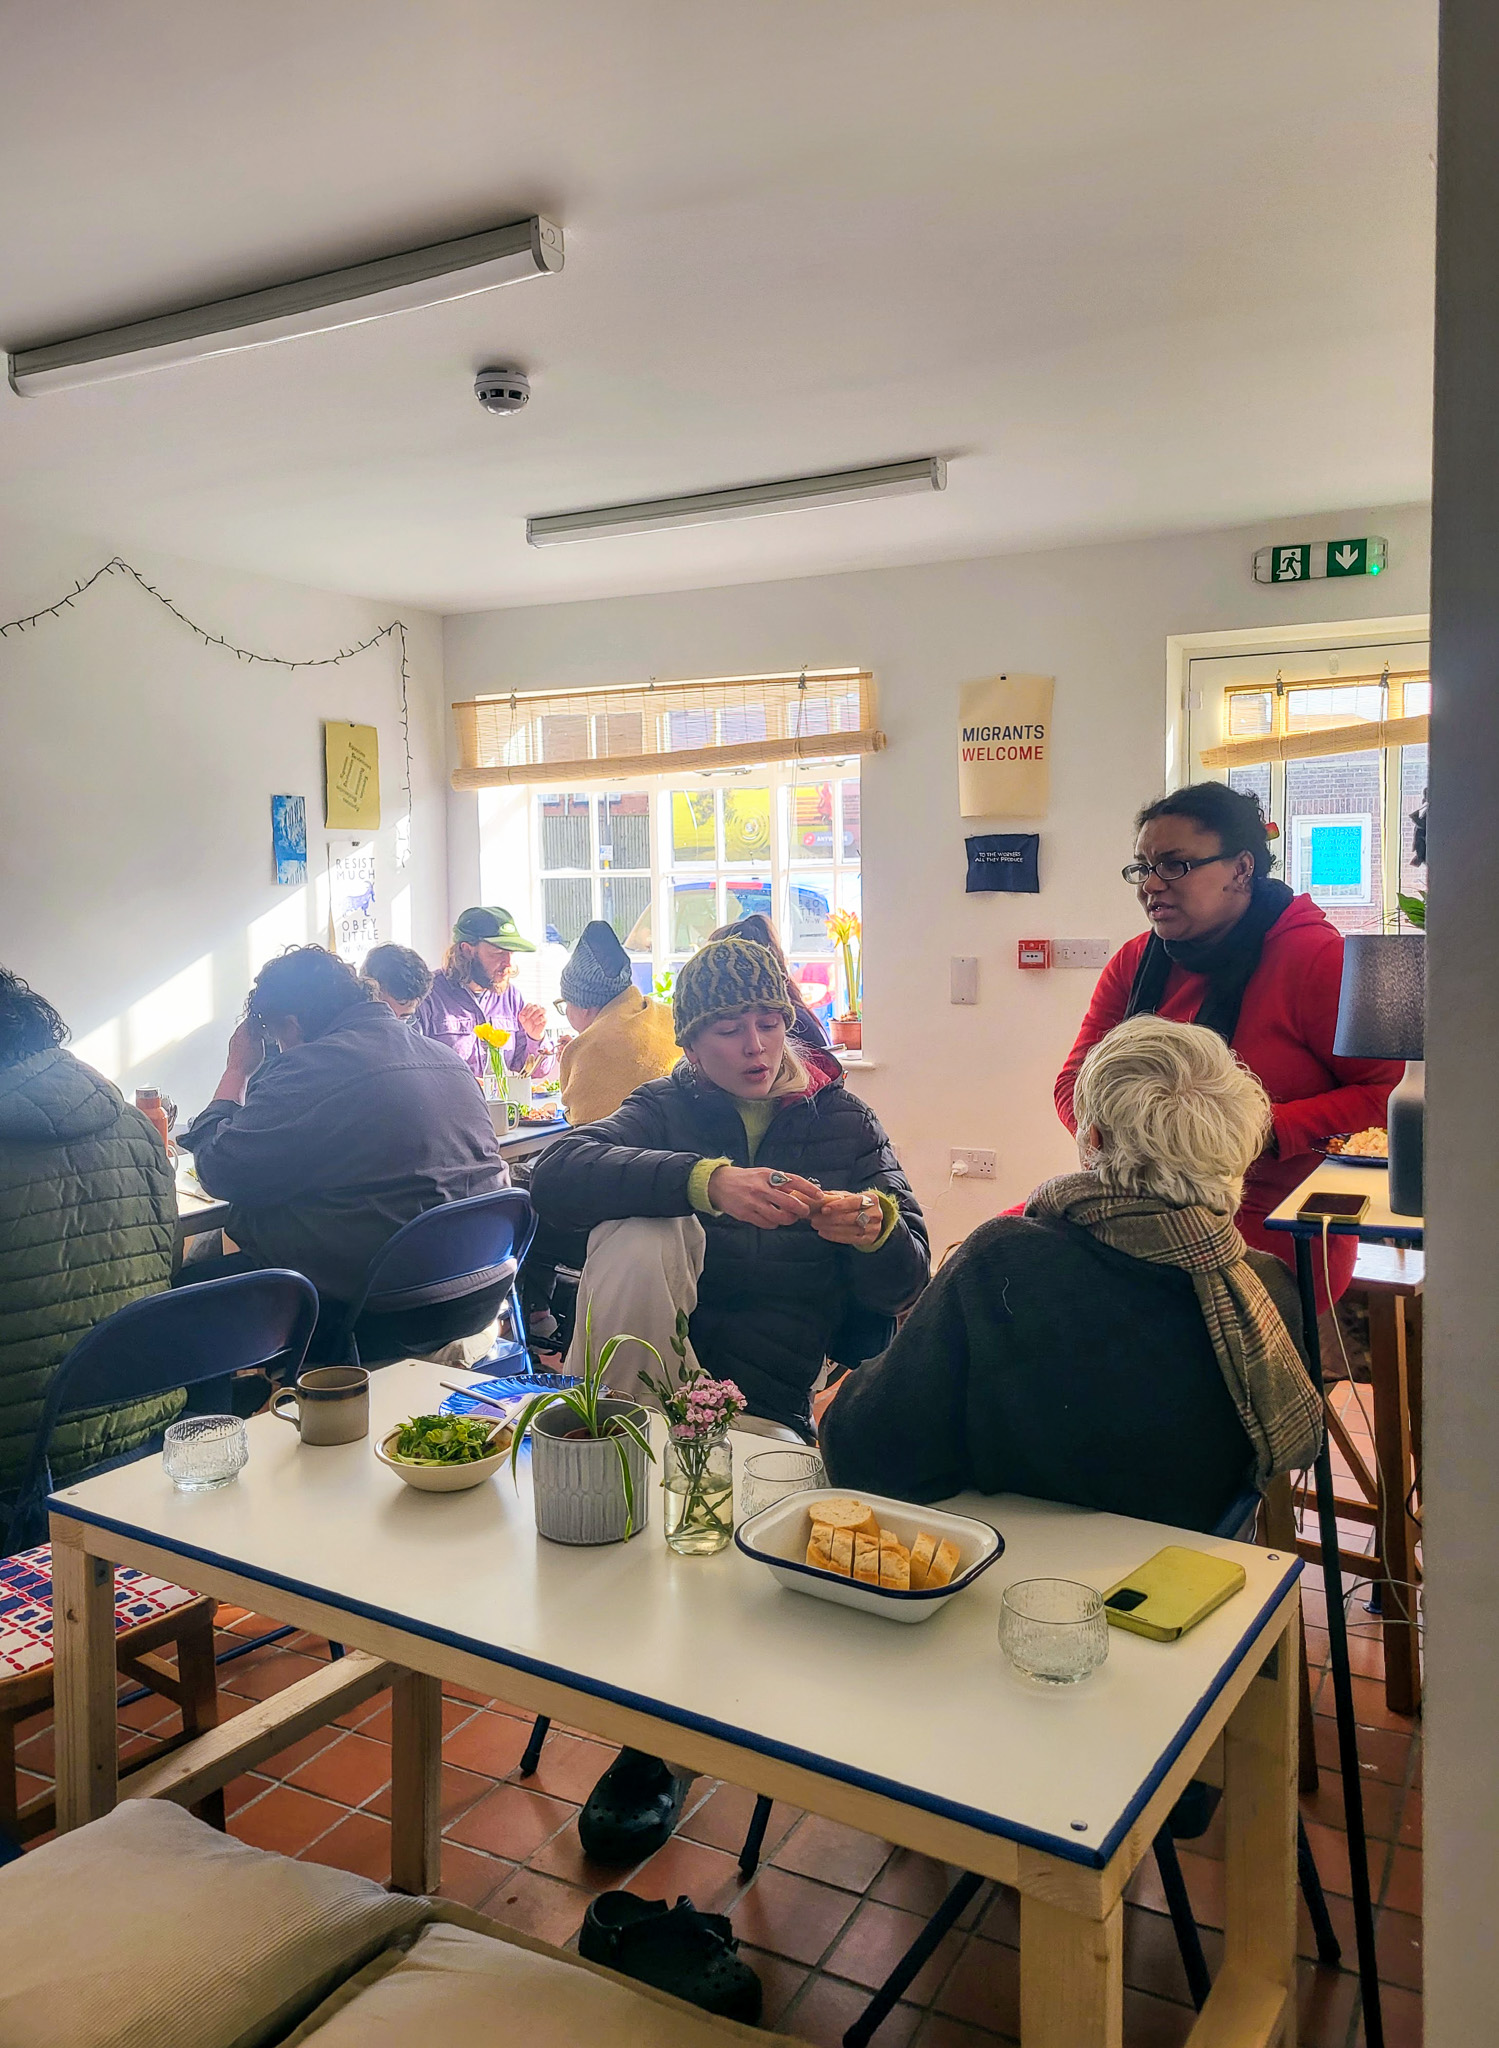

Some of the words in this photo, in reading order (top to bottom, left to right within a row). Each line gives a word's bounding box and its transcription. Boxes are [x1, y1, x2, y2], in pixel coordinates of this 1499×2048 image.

[962, 725, 1045, 741] MIGRANTS
[962, 745, 1044, 762] WELCOME
[336, 858, 375, 869] RESIST
[336, 869, 375, 880] MUCH
[341, 918, 377, 931] OBEY
[342, 929, 379, 943] LITTLE
